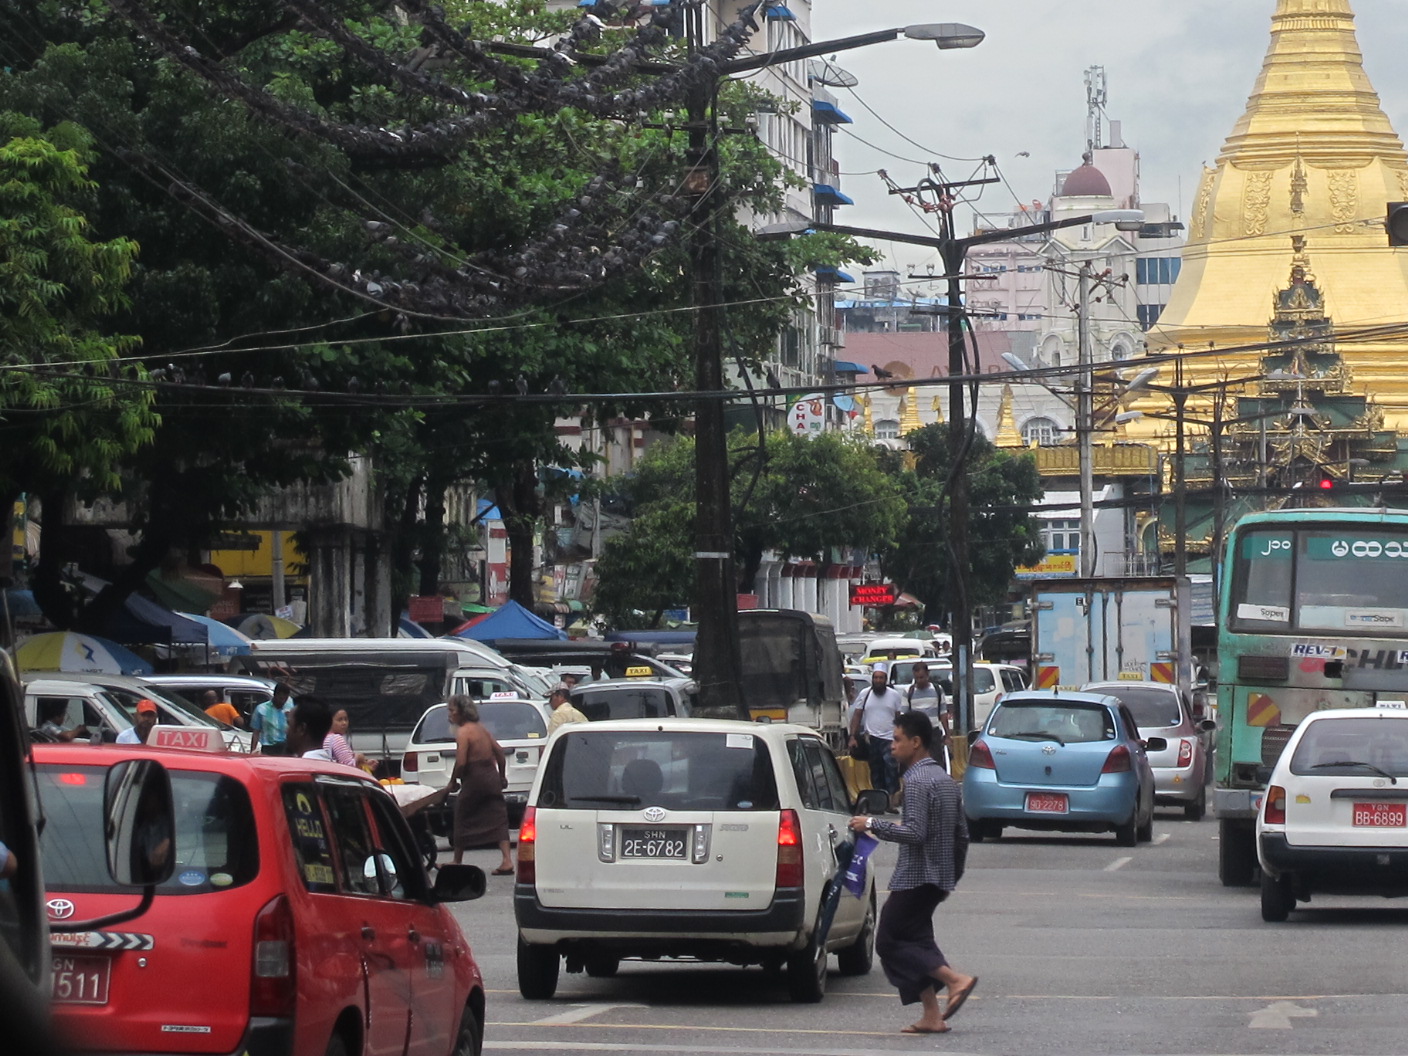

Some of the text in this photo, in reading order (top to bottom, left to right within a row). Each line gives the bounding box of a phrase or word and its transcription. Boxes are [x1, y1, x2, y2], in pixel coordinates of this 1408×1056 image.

[856, 586, 888, 594] MONEY
[852, 595, 894, 604] CHANGER
[1294, 644, 1337, 657] REV-1
[161, 731, 206, 747] TAXI
[1355, 811, 1403, 825] BB-6899
[644, 830, 666, 839] SHN
[624, 840, 684, 857] 2E-6782
[51, 958, 74, 971] GN
